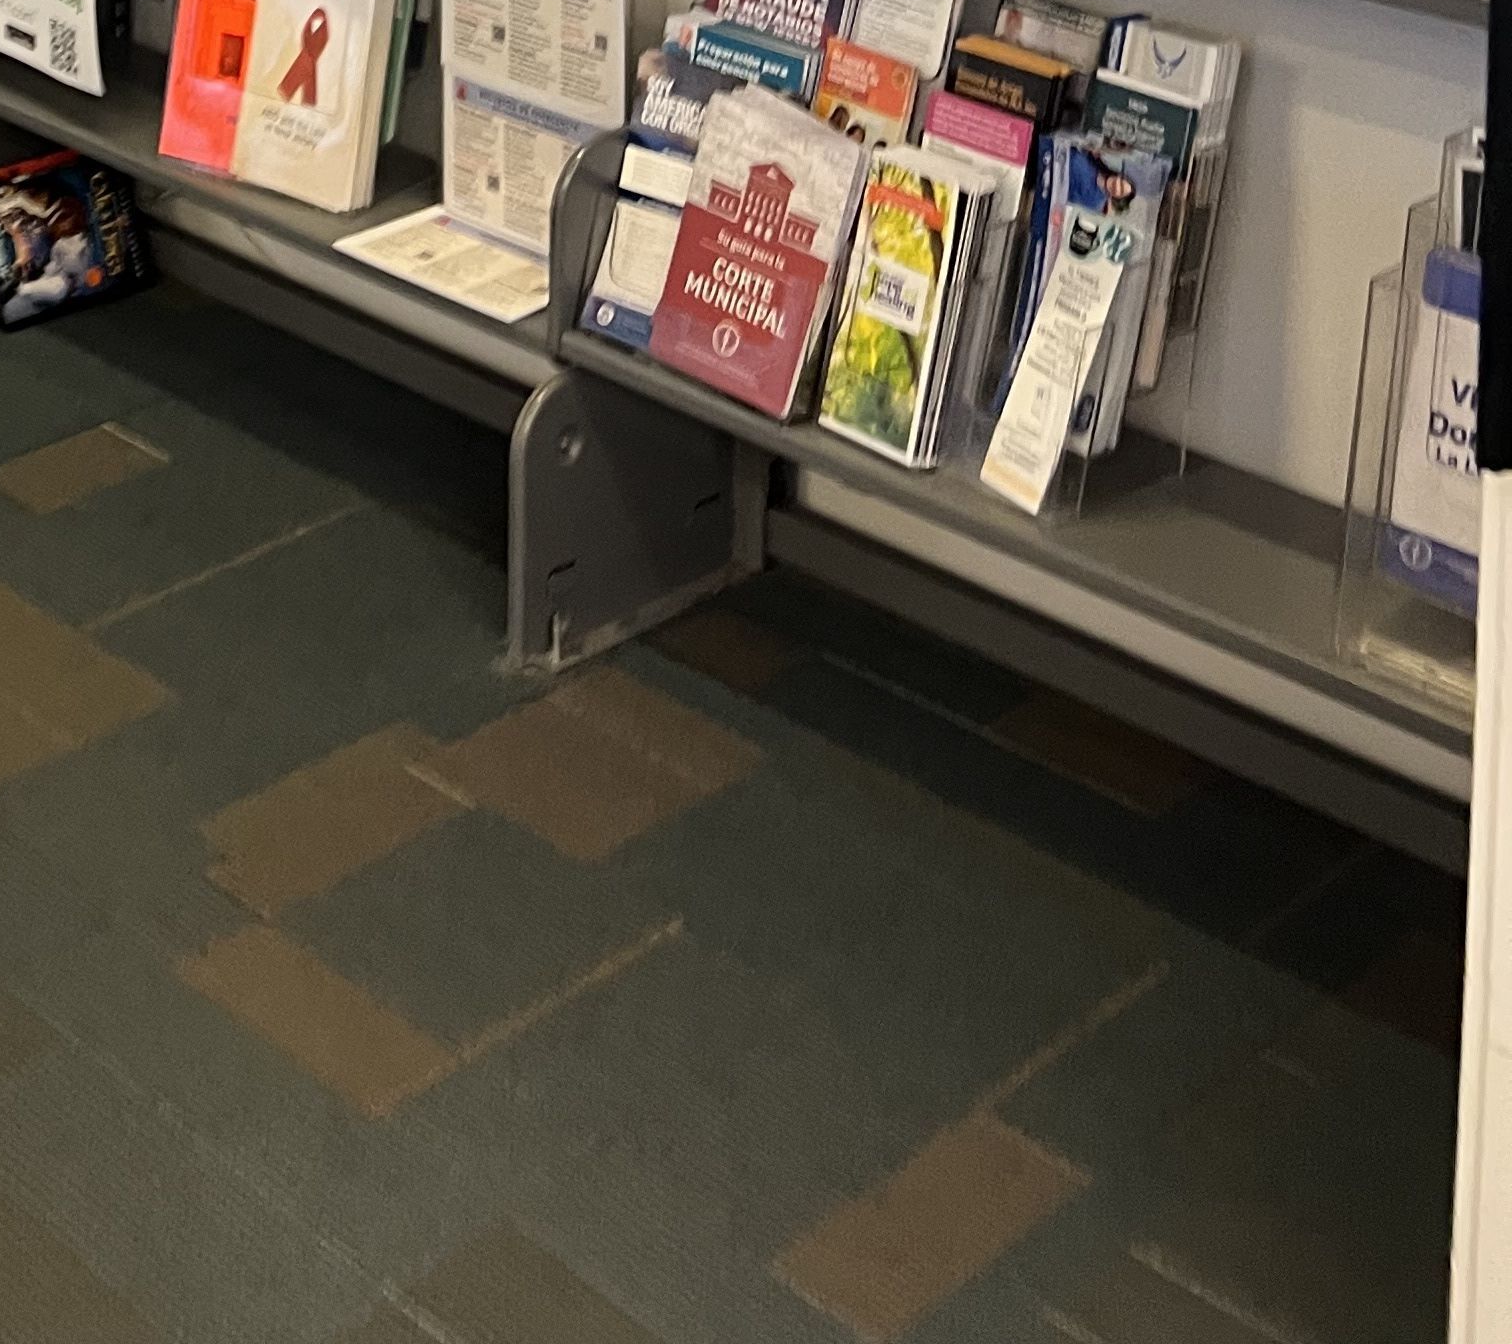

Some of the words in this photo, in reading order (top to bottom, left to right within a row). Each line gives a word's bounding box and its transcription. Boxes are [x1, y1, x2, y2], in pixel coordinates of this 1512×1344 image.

[750, 241, 776, 266] para
[712, 256, 775, 302] CORTE
[684, 270, 787, 340] MUNICIPAL
